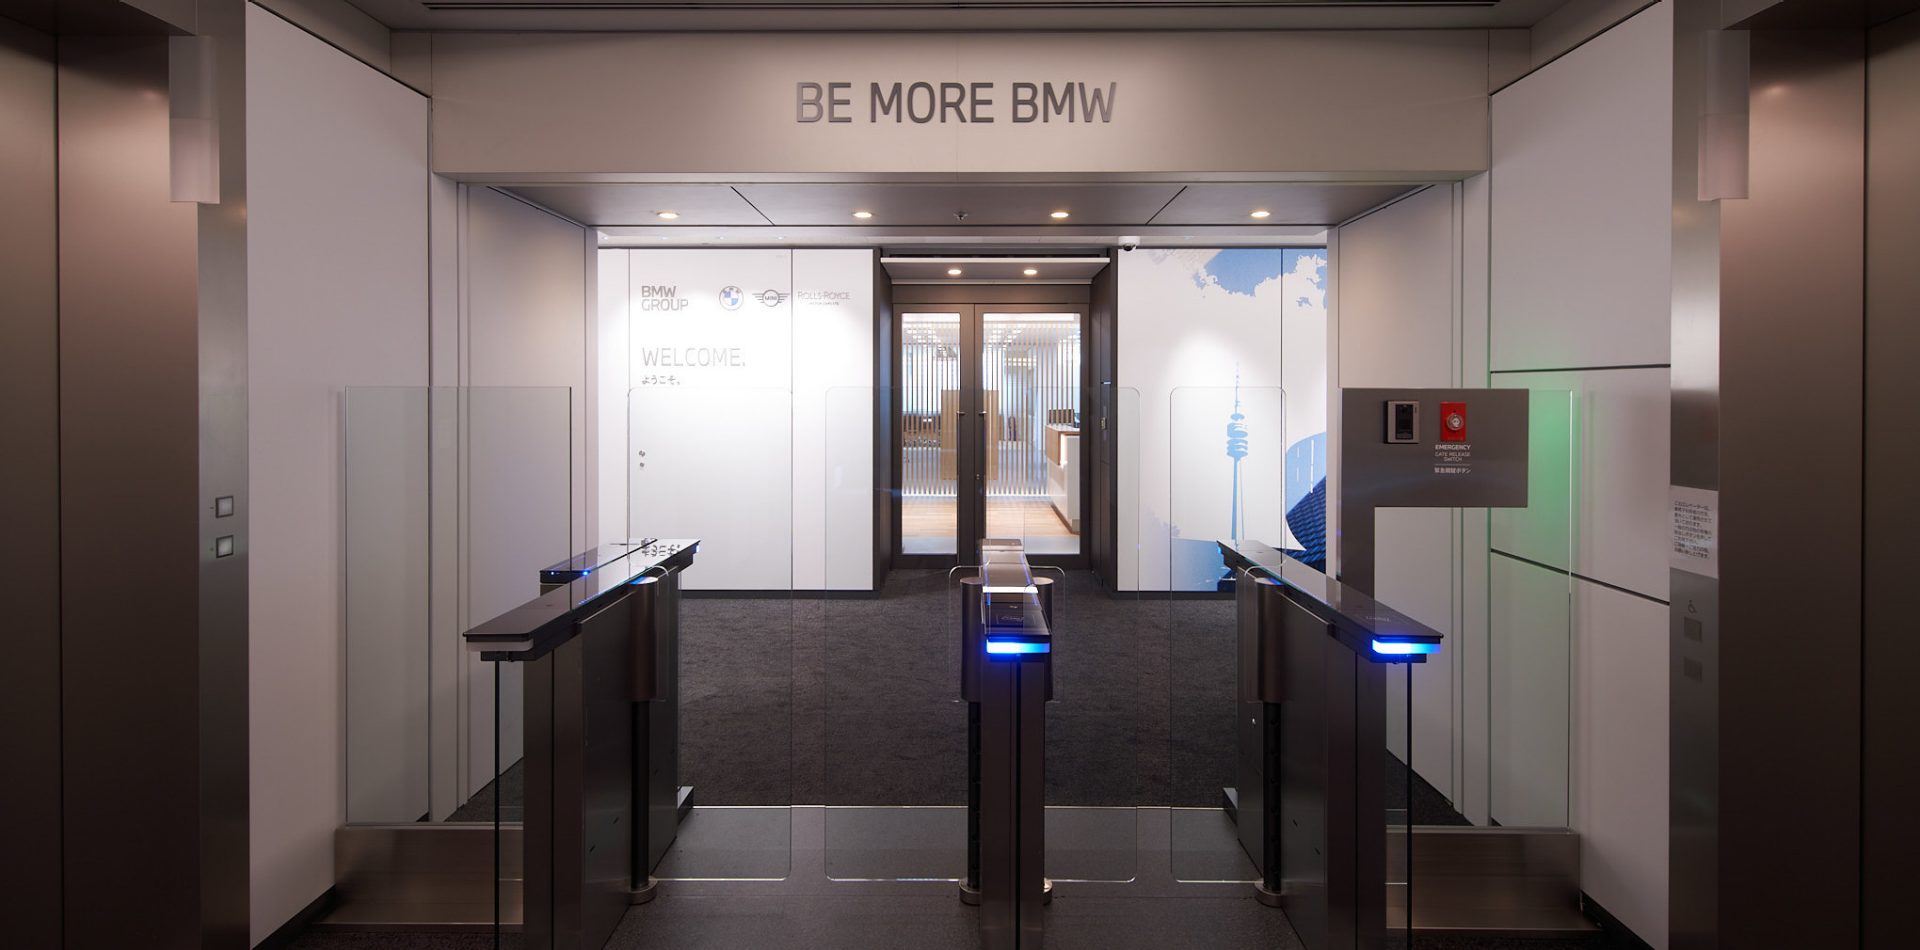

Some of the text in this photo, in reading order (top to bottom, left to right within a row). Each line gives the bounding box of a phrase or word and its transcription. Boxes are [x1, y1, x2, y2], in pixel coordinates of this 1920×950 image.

[796, 81, 1118, 124] BE MORE BMW
[641, 285, 677, 297] BMW
[641, 298, 689, 311] GROUP
[641, 347, 746, 367] WELCOME.
[641, 374, 681, 386] ようこそ。
